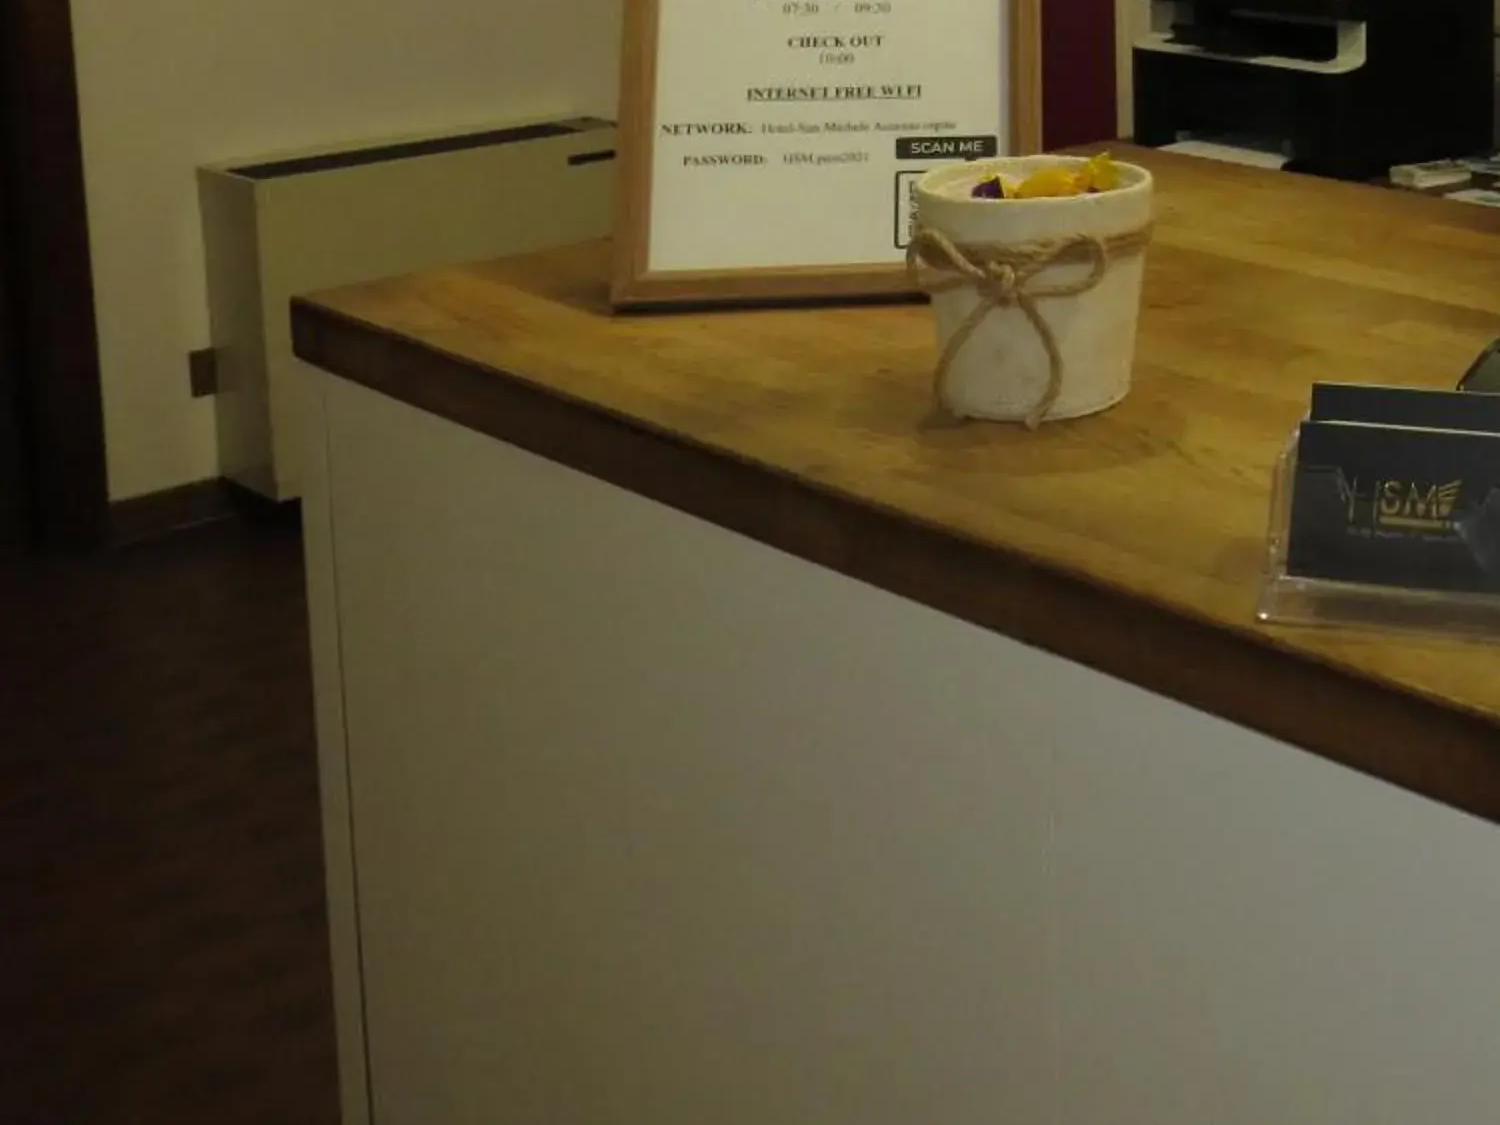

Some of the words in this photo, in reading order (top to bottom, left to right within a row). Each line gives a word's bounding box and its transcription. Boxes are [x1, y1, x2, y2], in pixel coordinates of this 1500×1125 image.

[787, 35, 845, 50] CHECK
[848, 34, 885, 49] OUT
[747, 86, 828, 101] INTERNET
[832, 85, 874, 100] FREE
[661, 120, 753, 136] NETWORK:
[911, 141, 955, 154] SCAN
[959, 140, 985, 153] ME
[682, 153, 767, 168] PASSWORD:
